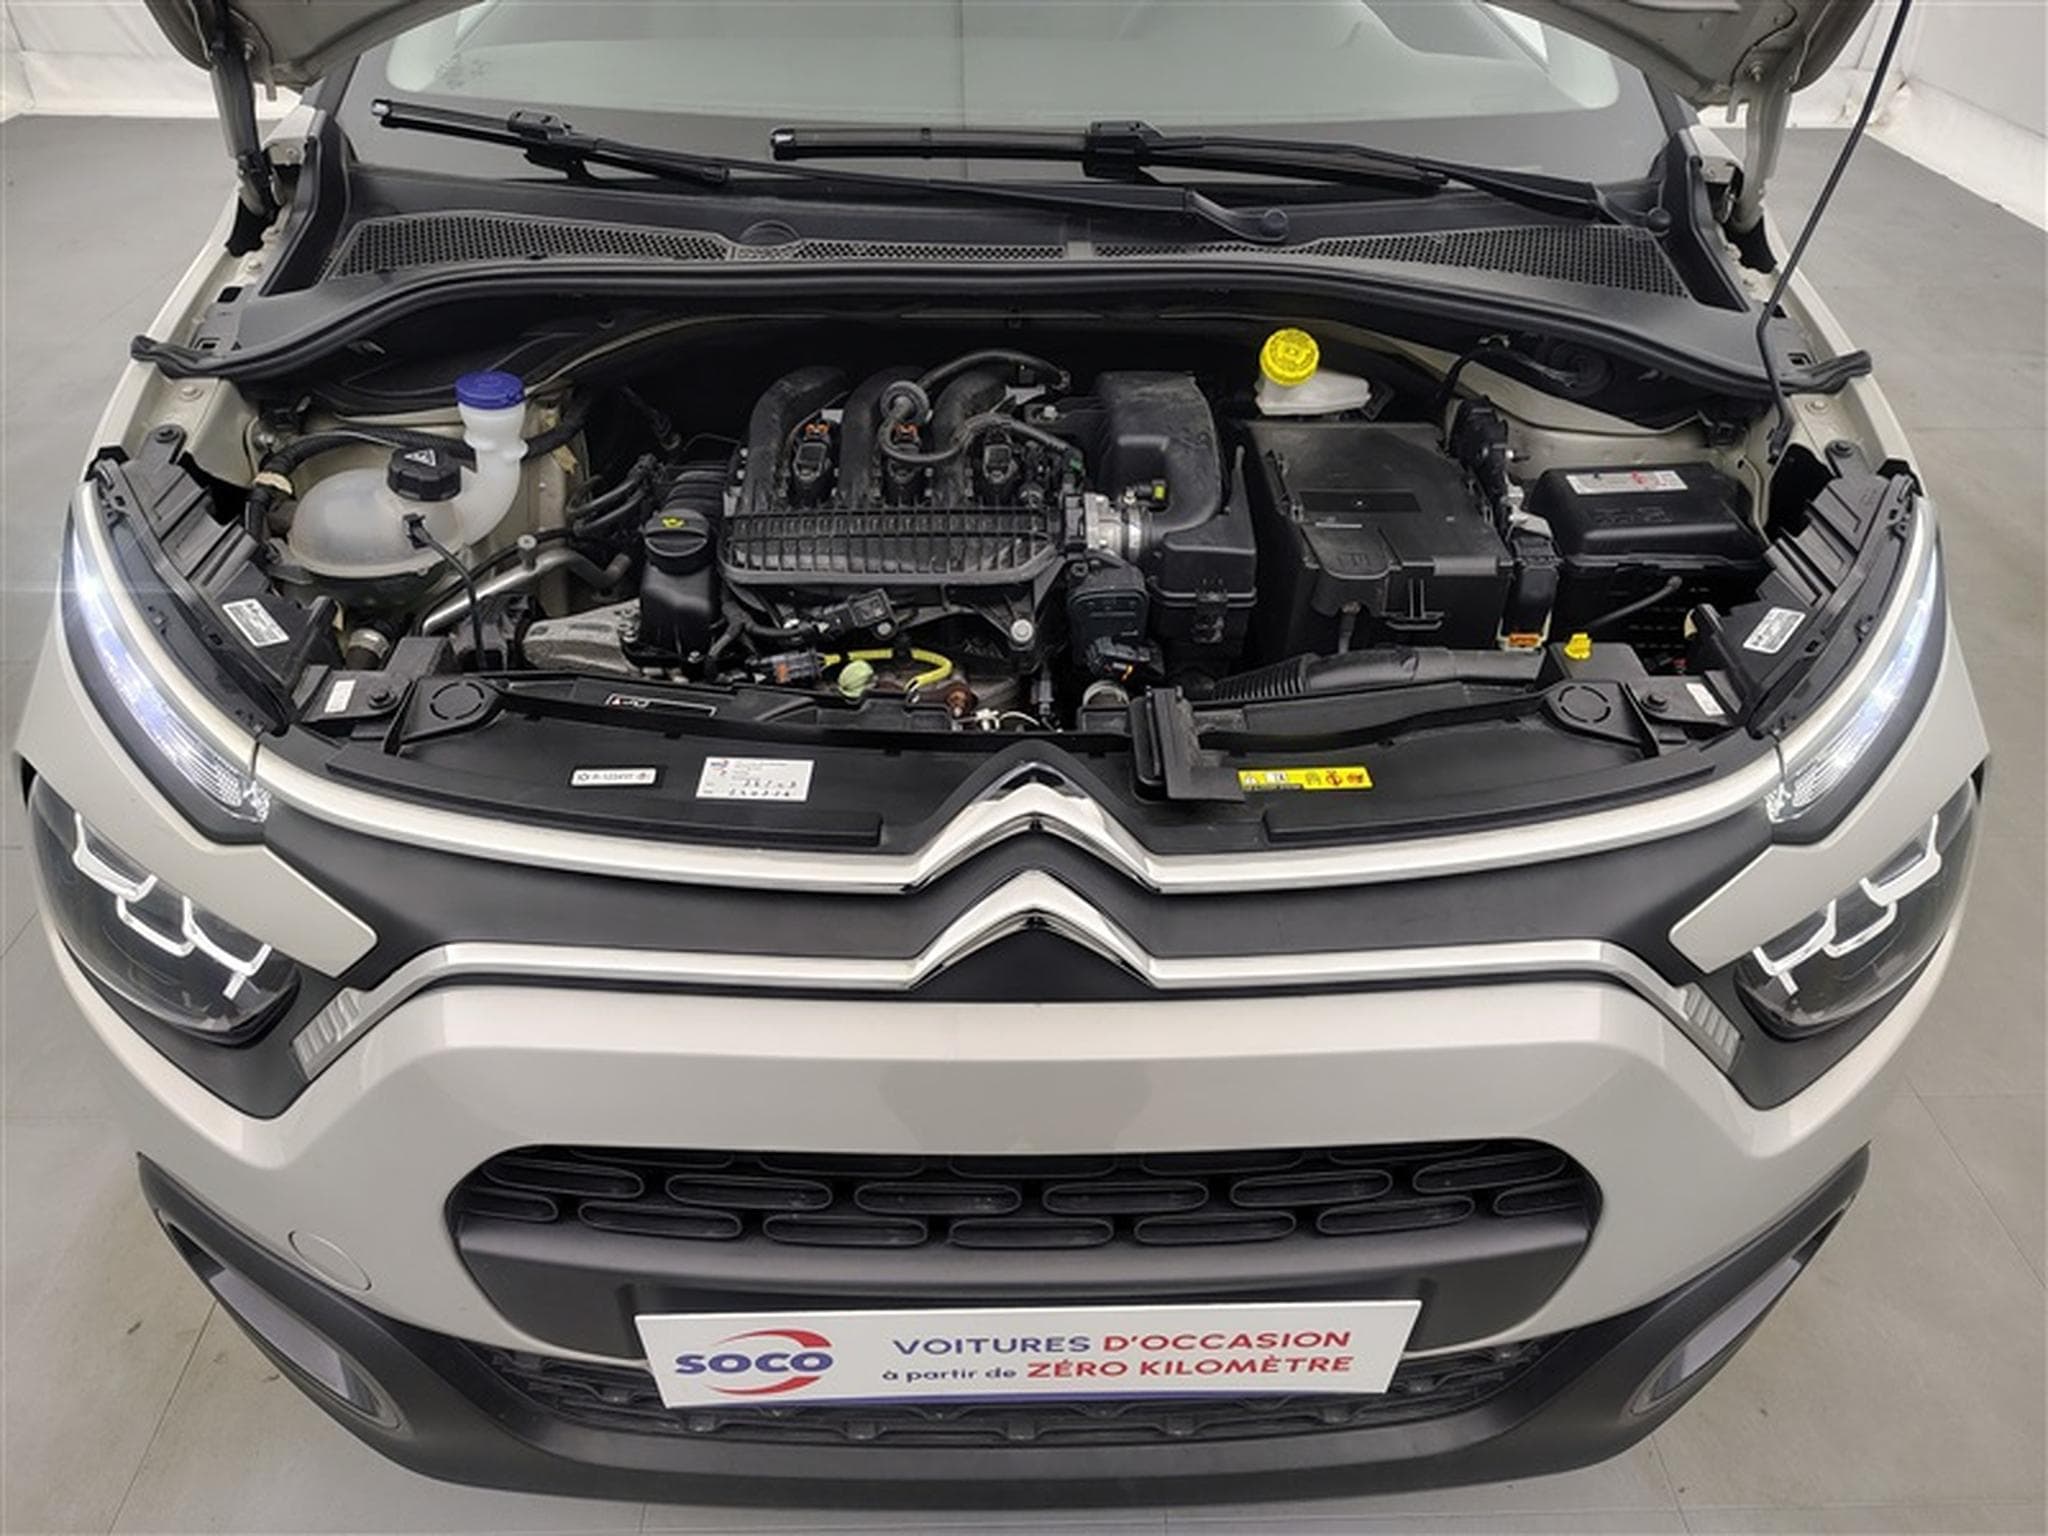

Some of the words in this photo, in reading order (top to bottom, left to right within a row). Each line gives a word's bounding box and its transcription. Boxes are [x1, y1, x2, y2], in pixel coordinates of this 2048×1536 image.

[893, 1336, 1091, 1355] VOITURES
[1103, 1331, 1351, 1351] D'OCCASION
[675, 1352, 833, 1374] SOCO
[882, 1369, 898, 1380] à
[906, 1368, 978, 1383] partir
[985, 1367, 1017, 1379] de
[1027, 1359, 1128, 1378] ZÉRO
[1140, 1355, 1354, 1376] KILOMÈTRE
